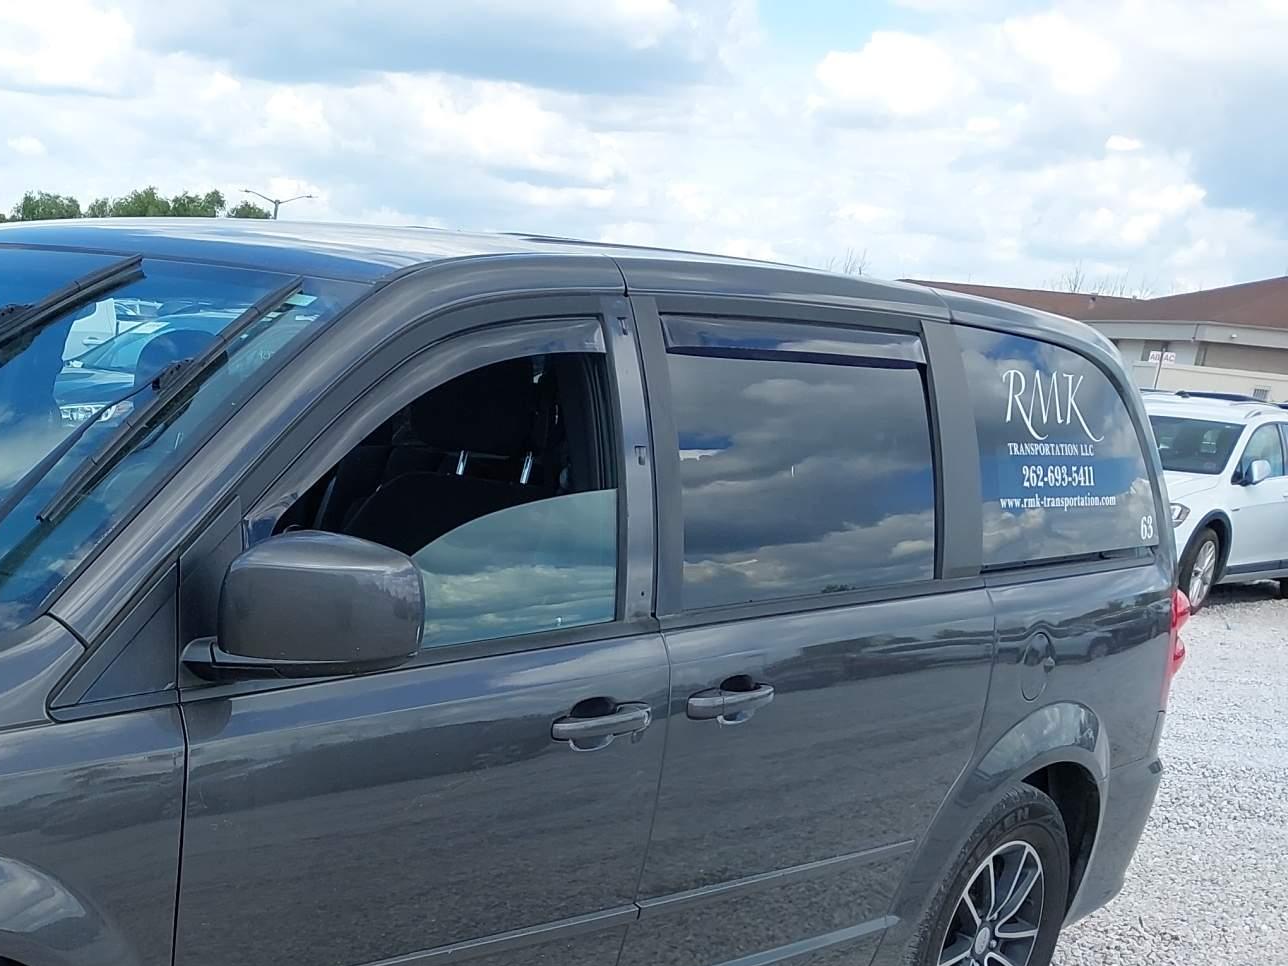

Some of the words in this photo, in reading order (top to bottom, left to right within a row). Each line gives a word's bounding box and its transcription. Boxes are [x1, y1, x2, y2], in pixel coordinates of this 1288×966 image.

[1002, 369, 1105, 442] RMK
[1008, 442, 1078, 456] TRANSPORTATION
[1080, 444, 1095, 456] LLC
[1022, 465, 1095, 488] 262-693-5411
[1000, 492, 1117, 512] www.rmk-transportation.com
[1140, 515, 1154, 540] 63
